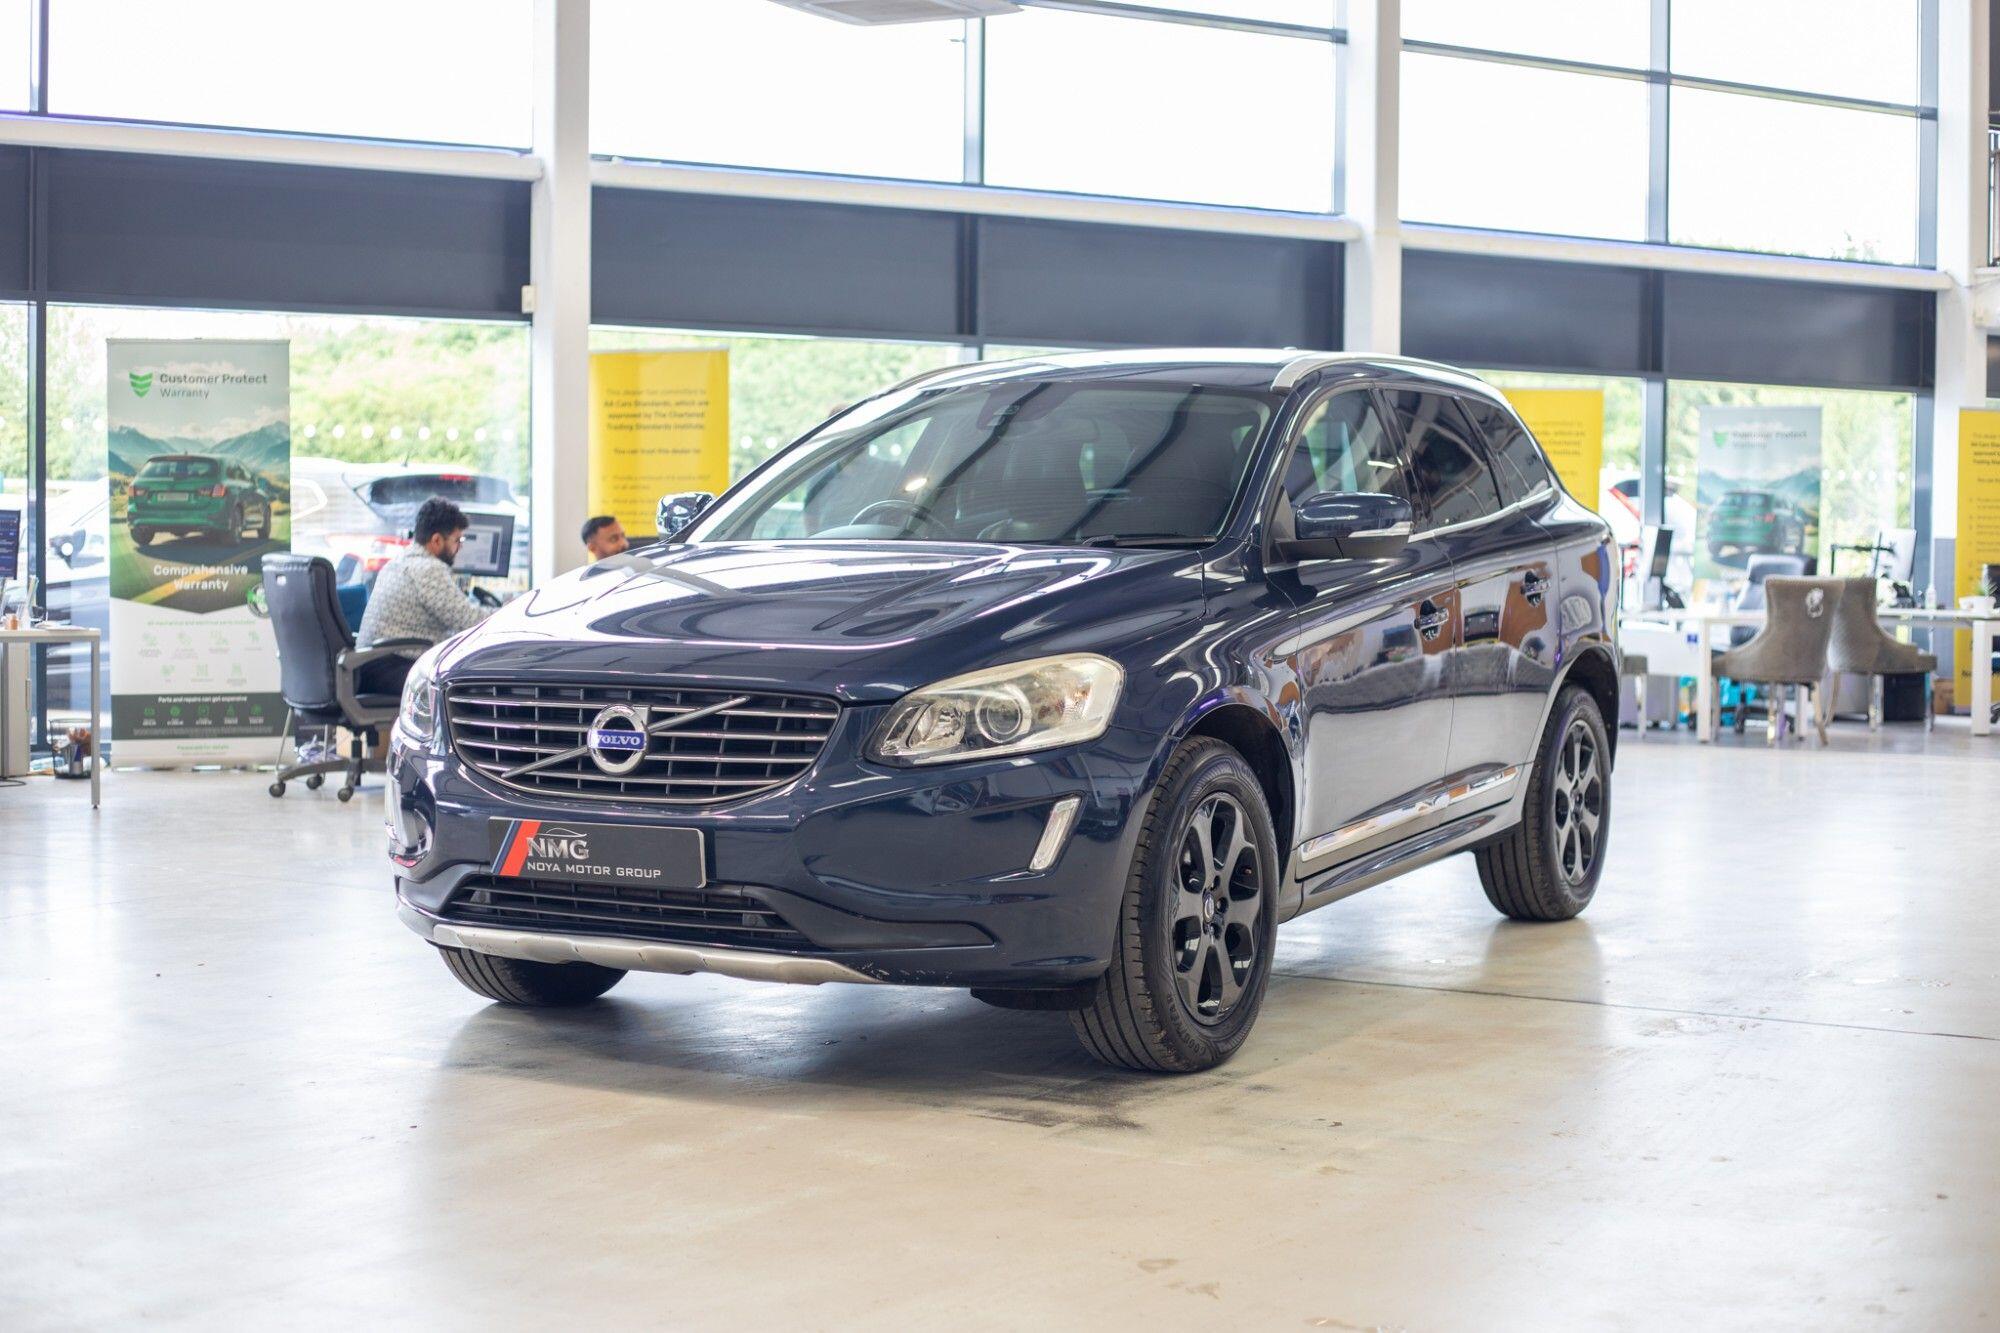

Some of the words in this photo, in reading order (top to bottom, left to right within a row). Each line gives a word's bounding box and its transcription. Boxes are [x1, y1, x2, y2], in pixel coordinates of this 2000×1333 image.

[160, 373, 218, 384] Customer
[222, 373, 268, 384] Protect
[160, 388, 210, 399] Warranty
[153, 564, 248, 576] Comprehensive
[174, 579, 229, 591] Warranty
[594, 735, 641, 746] VOLVO
[526, 837, 589, 860] NMG
[527, 862, 561, 872] NOYA
[566, 864, 611, 875] MOTOR
[616, 867, 661, 878] GROUP
